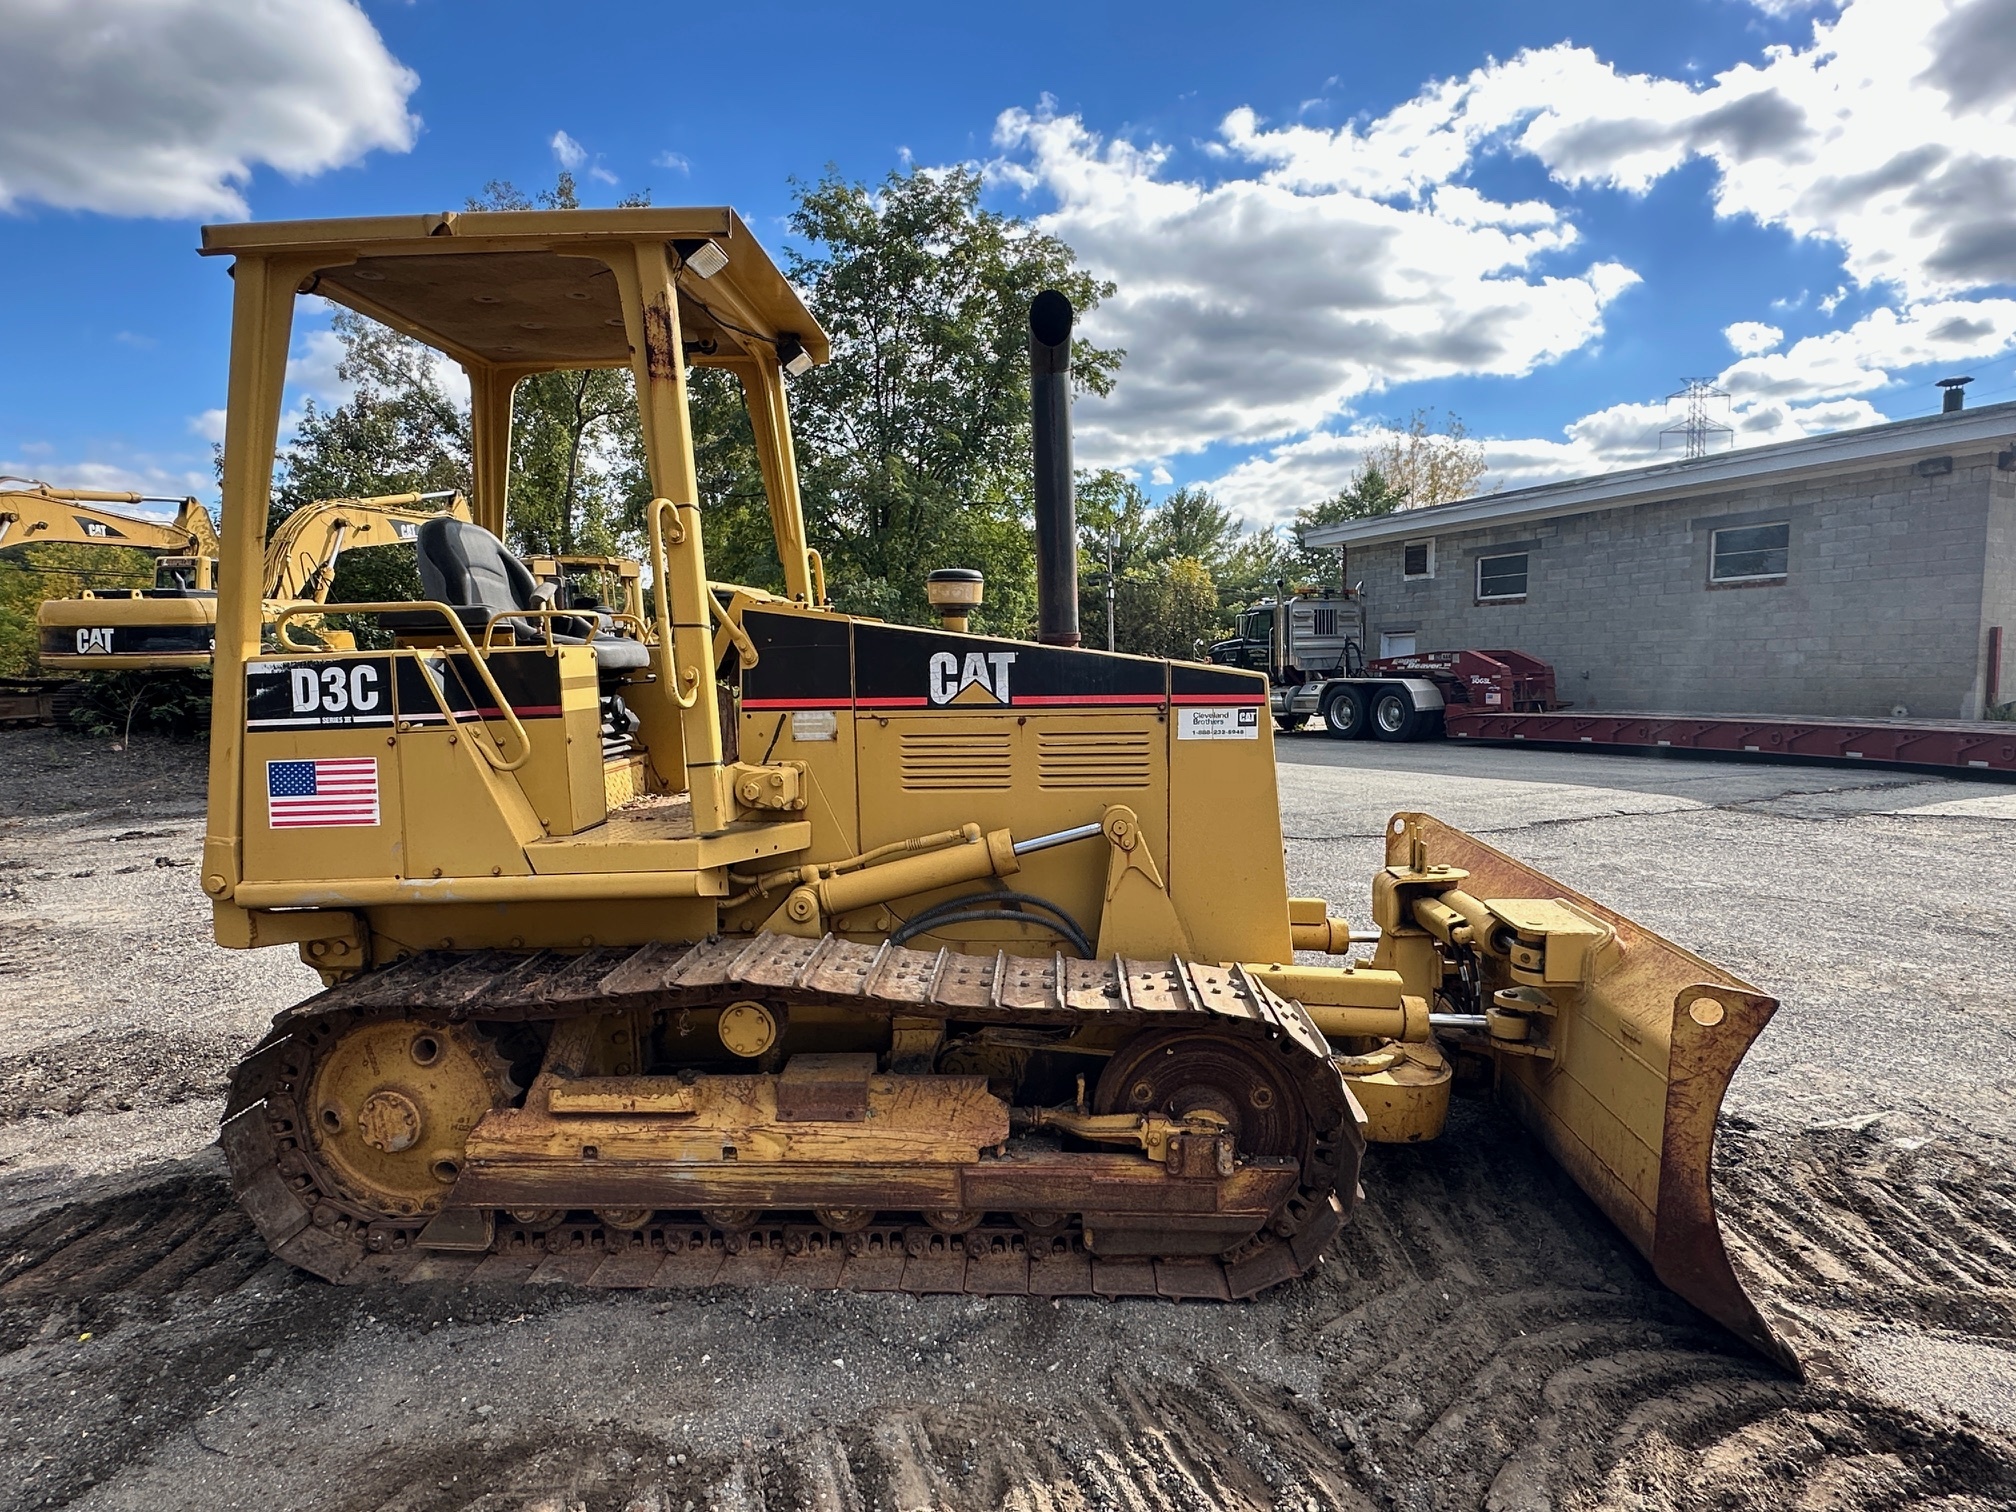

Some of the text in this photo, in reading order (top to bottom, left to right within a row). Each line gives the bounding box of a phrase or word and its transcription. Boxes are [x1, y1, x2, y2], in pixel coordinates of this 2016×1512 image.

[88, 523, 107, 537] CAT
[400, 523, 416, 538] CAT
[76, 628, 114, 654] CAT
[209, 638, 216, 650] 3
[929, 651, 1016, 705] CAT
[291, 664, 379, 712] D3C
[321, 716, 343, 724] SERIES
[1239, 712, 1256, 722] CAT
